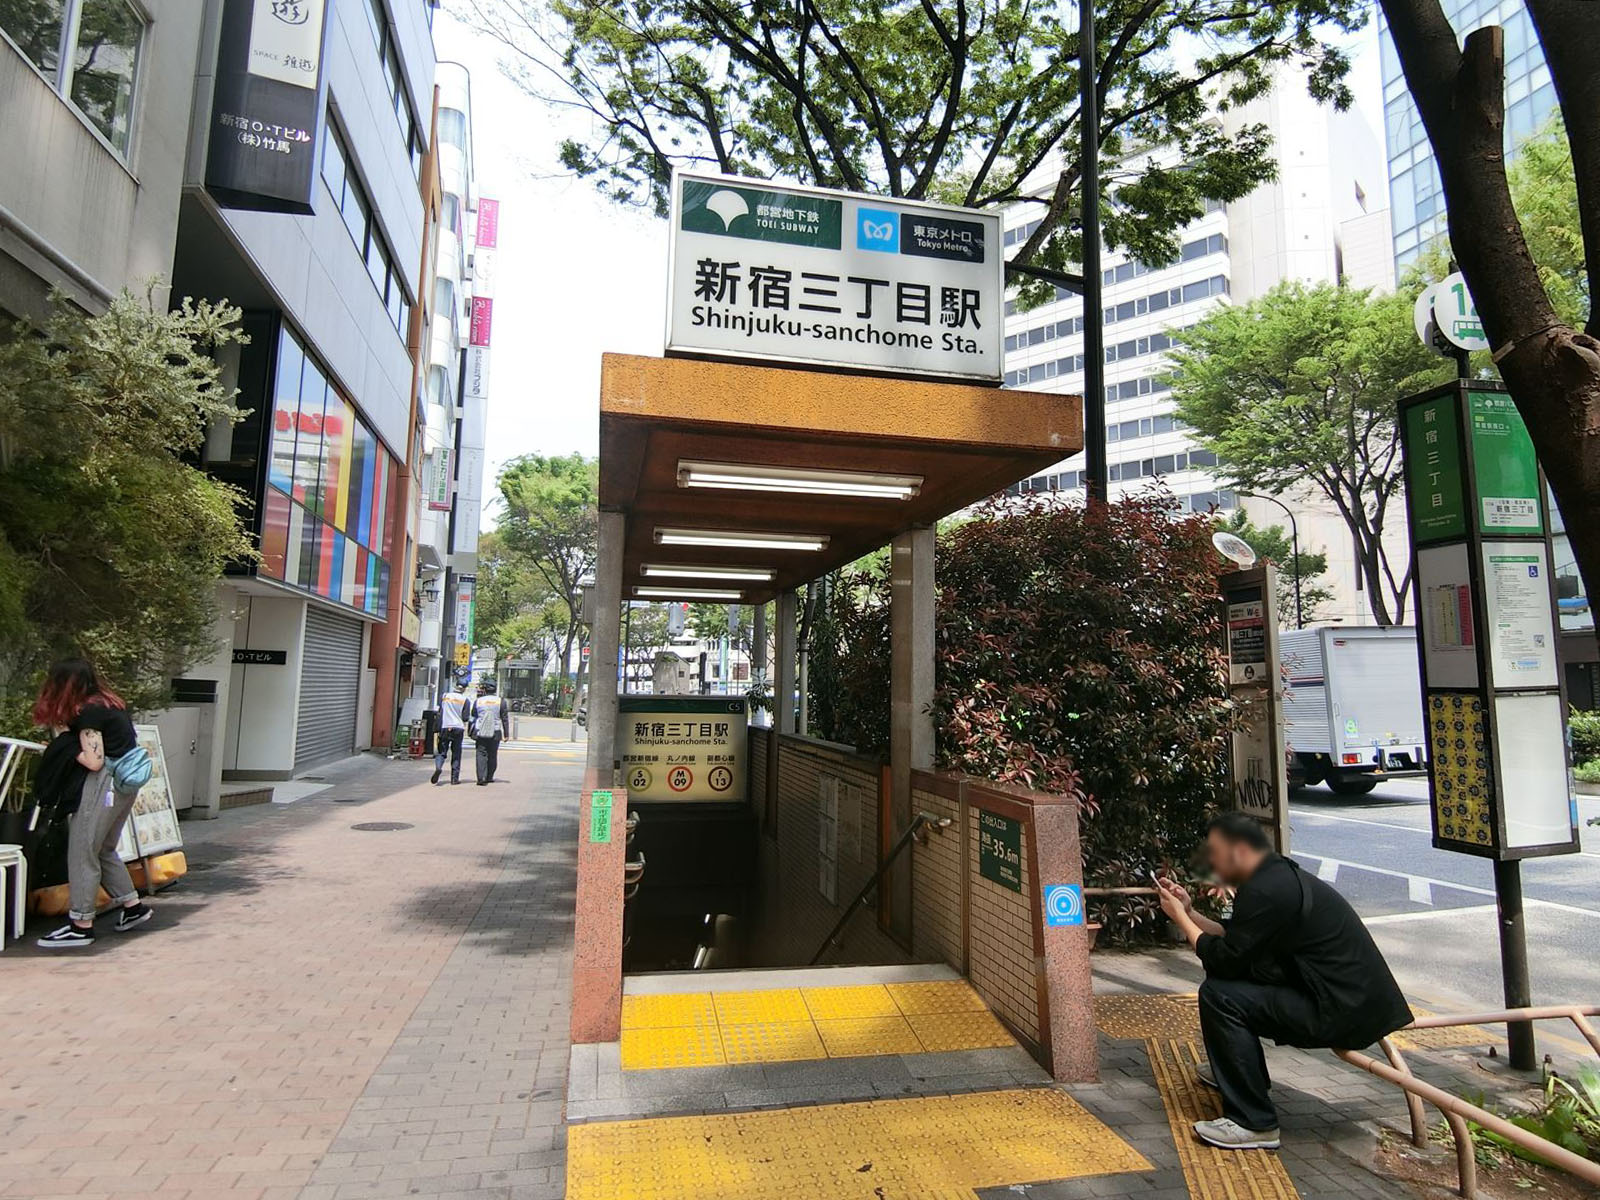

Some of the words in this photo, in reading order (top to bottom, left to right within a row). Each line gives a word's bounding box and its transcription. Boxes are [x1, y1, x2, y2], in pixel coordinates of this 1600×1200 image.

[756, 204, 820, 224] 都営地下鉄
[756, 218, 777, 229] TOEI
[780, 221, 820, 235] SUBWAY
[913, 225, 972, 243] 東京メトロ
[917, 238, 942, 250] Tokyo
[943, 242, 969, 253] Metro
[694, 257, 982, 331] 新宿三丁目駅
[1451, 282, 1478, 317] 1
[691, 306, 934, 351] Shinjuku-sanchome
[942, 333, 985, 356] Sta.
[1424, 408, 1443, 507] 新宿三丁目
[232, 652, 272, 661] O・Tビル
[728, 702, 740, 711] C5
[634, 722, 729, 738] 新宿三丁目駅
[634, 738, 711, 746] Shinjuku-sanchome
[633, 779, 646, 787] 02
[674, 779, 687, 787] 09
[715, 779, 727, 787] 13
[993, 838, 1019, 865] 35.6m
